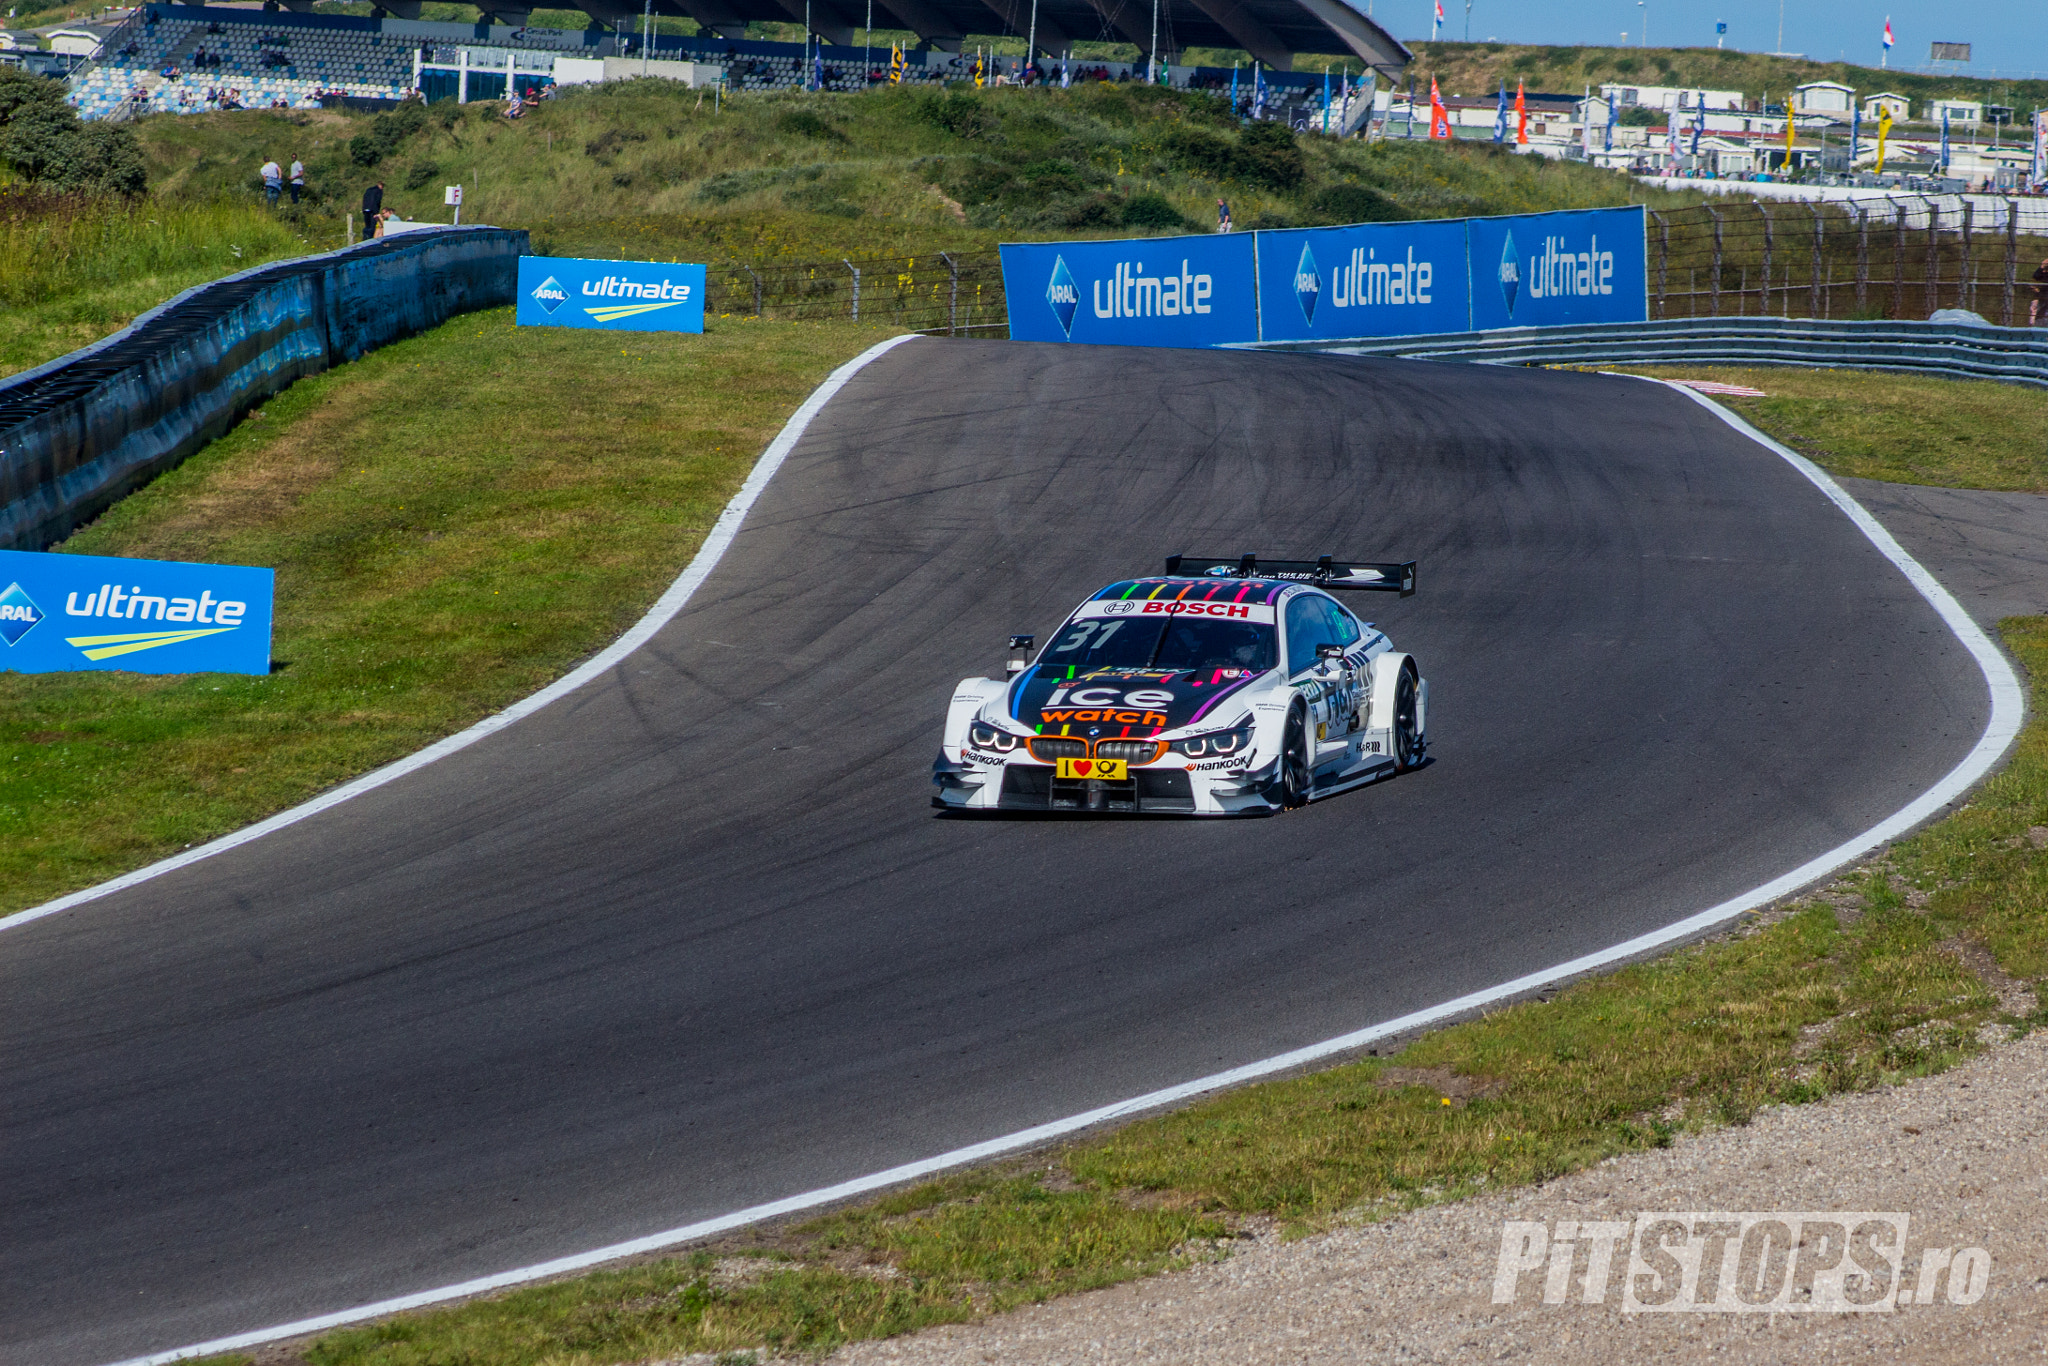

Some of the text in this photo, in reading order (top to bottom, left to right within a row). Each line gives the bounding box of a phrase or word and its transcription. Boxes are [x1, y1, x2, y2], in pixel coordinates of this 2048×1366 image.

[454, 189, 460, 203] F
[1297, 245, 1433, 307] ARAL ultimate
[1529, 234, 1613, 299] ultimate
[535, 276, 691, 301] ARAL ultimate
[1052, 258, 1212, 319] ARAL ultimate
[0, 584, 247, 626] RAL ultimate
[1142, 601, 1250, 618] BOSCH
[1055, 620, 1126, 652] 31
[1046, 684, 1175, 708] ice
[1041, 708, 1168, 727] watch
